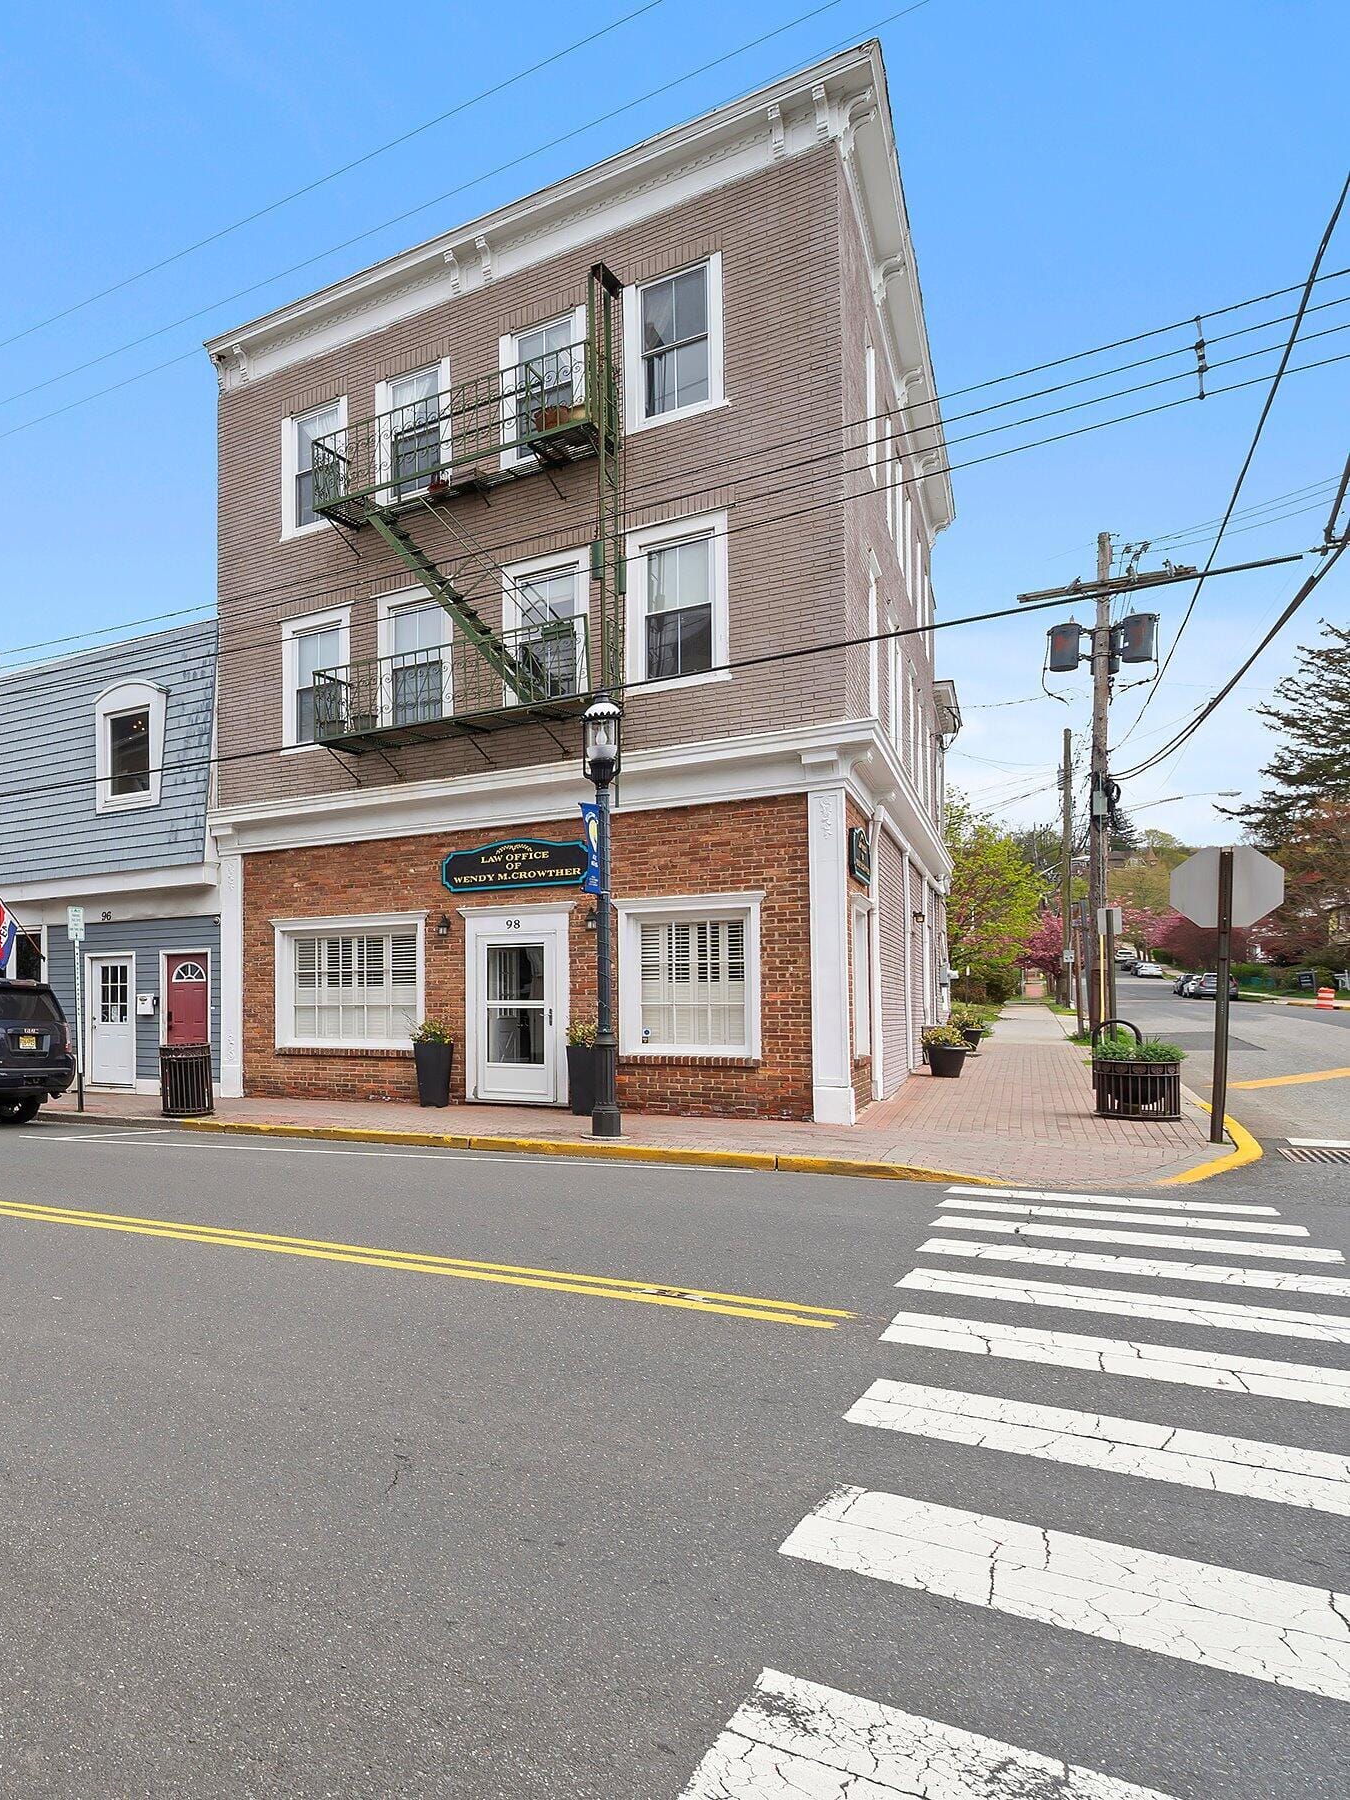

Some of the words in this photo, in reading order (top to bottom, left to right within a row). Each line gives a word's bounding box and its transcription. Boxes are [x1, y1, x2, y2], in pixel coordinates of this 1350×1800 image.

[480, 855, 503, 864] LAW
[505, 851, 550, 862] OFFICE
[505, 862, 522, 871] OF
[453, 874, 495, 884] WENDY
[101, 911, 112, 921] 96
[505, 919, 521, 930] 98
